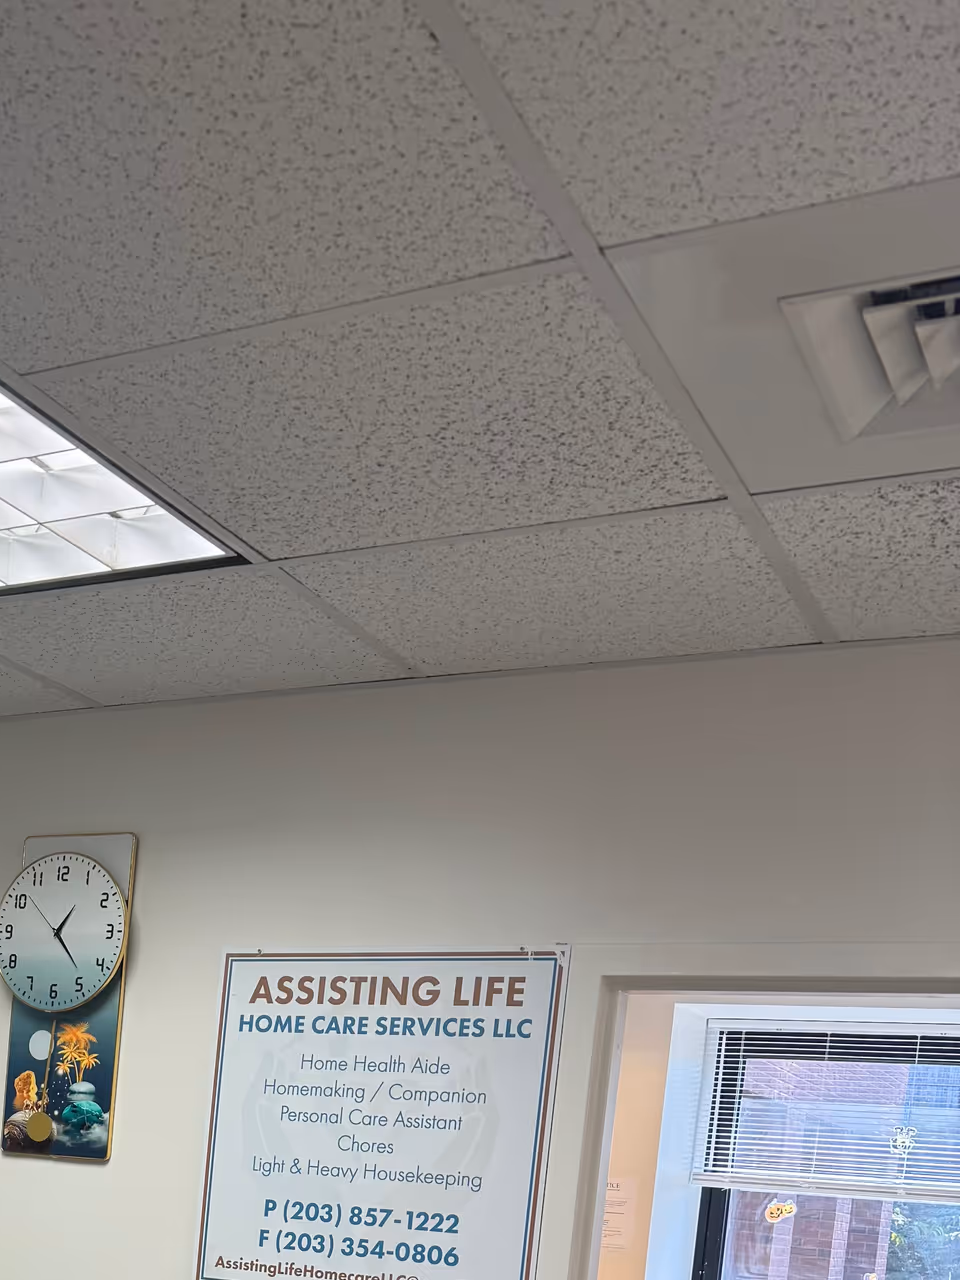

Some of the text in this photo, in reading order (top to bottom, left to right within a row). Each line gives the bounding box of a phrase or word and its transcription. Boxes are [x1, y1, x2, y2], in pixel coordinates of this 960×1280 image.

[33, 872, 43, 886] 11
[57, 866, 70, 881] 12
[86, 870, 90, 886] 1
[14, 894, 27, 909] 10
[100, 892, 109, 908] 2
[5, 924, 13, 940] 9
[106, 924, 114, 940] 3
[9, 954, 17, 969] 8
[96, 958, 105, 972] 4
[26, 976, 34, 991] 7
[50, 984, 58, 999] 6
[75, 976, 83, 992] 5
[248, 976, 526, 1006] ASSISTING LIFE
[238, 1014, 532, 1038] HOME CARE SERVICES LLC
[300, 1054, 450, 1075] Home Health Aide
[263, 1078, 487, 1106] Homemaking / Companion
[280, 1105, 463, 1131] Personal Care Assistant
[337, 1134, 394, 1154] Chores
[252, 1155, 483, 1192] Light & Heavy Housekeeping
[263, 1199, 460, 1234] P (203) 857-1222
[258, 1229, 459, 1267] F (203) 354-0806
